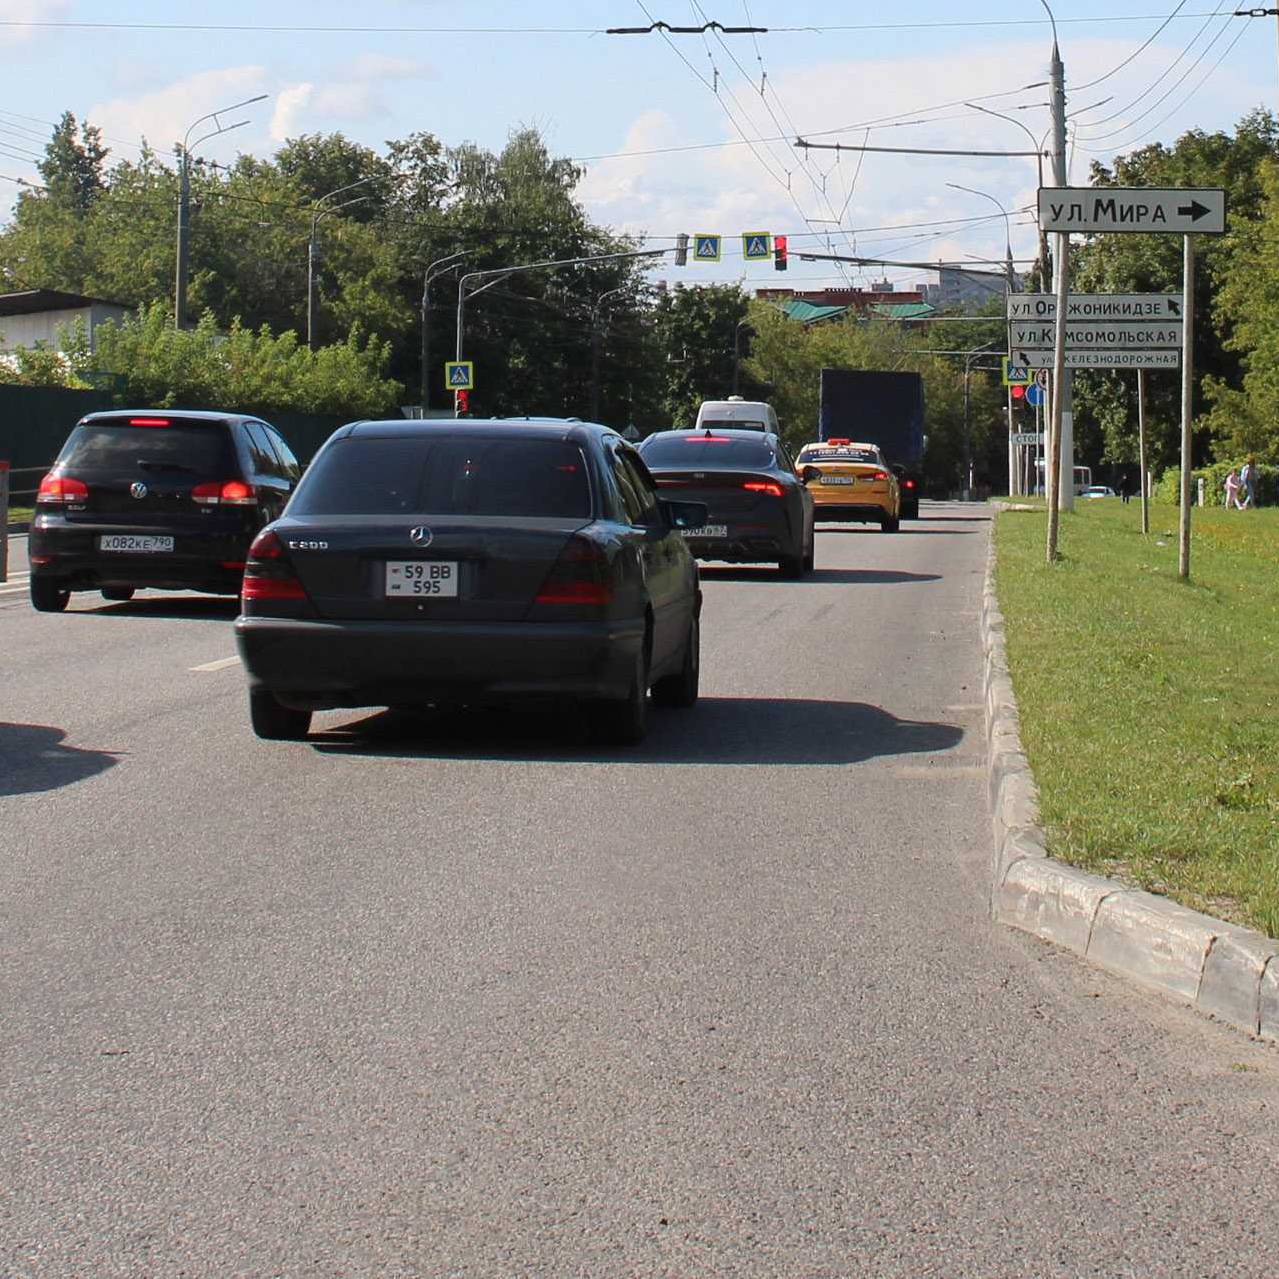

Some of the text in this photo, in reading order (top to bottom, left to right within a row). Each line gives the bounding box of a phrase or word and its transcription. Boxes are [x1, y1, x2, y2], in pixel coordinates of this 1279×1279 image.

[1036, 300, 1162, 316] ОРЖОНИКИДЗЕ
[1041, 328, 1177, 343] КМСОМОЛЬСКАЯ
[405, 565, 424, 579] 59
[413, 581, 441, 594] 595
